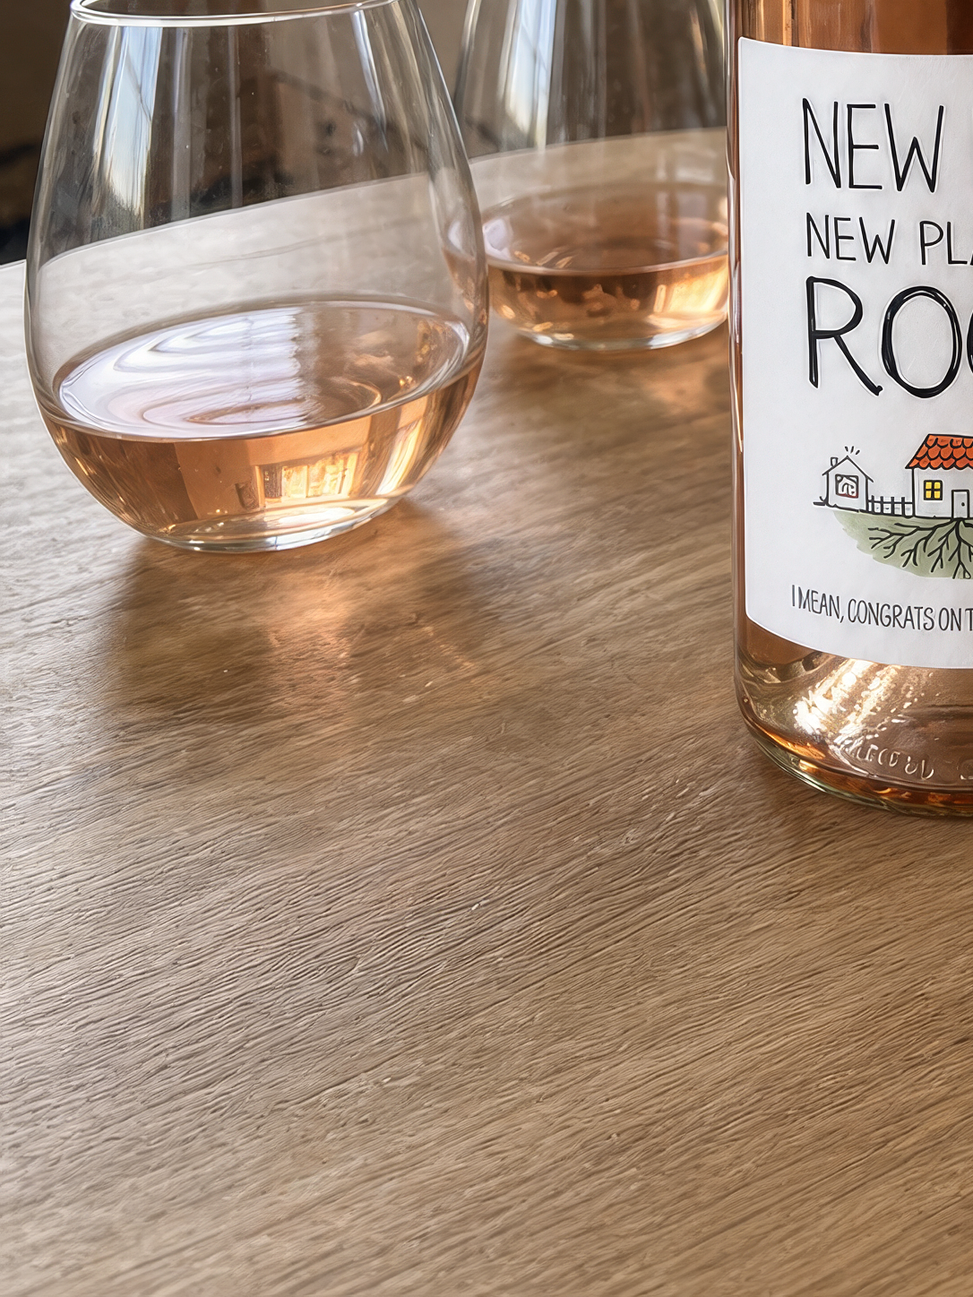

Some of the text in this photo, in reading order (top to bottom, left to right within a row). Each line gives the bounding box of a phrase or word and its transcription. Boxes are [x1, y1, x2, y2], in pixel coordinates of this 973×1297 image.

[802, 97, 945, 194] NEW
[806, 212, 896, 265] NEW
[791, 584, 796, 607] I
[798, 586, 845, 624] MEAN,
[847, 598, 935, 632] CONGRATS
[938, 607, 962, 632] ON
